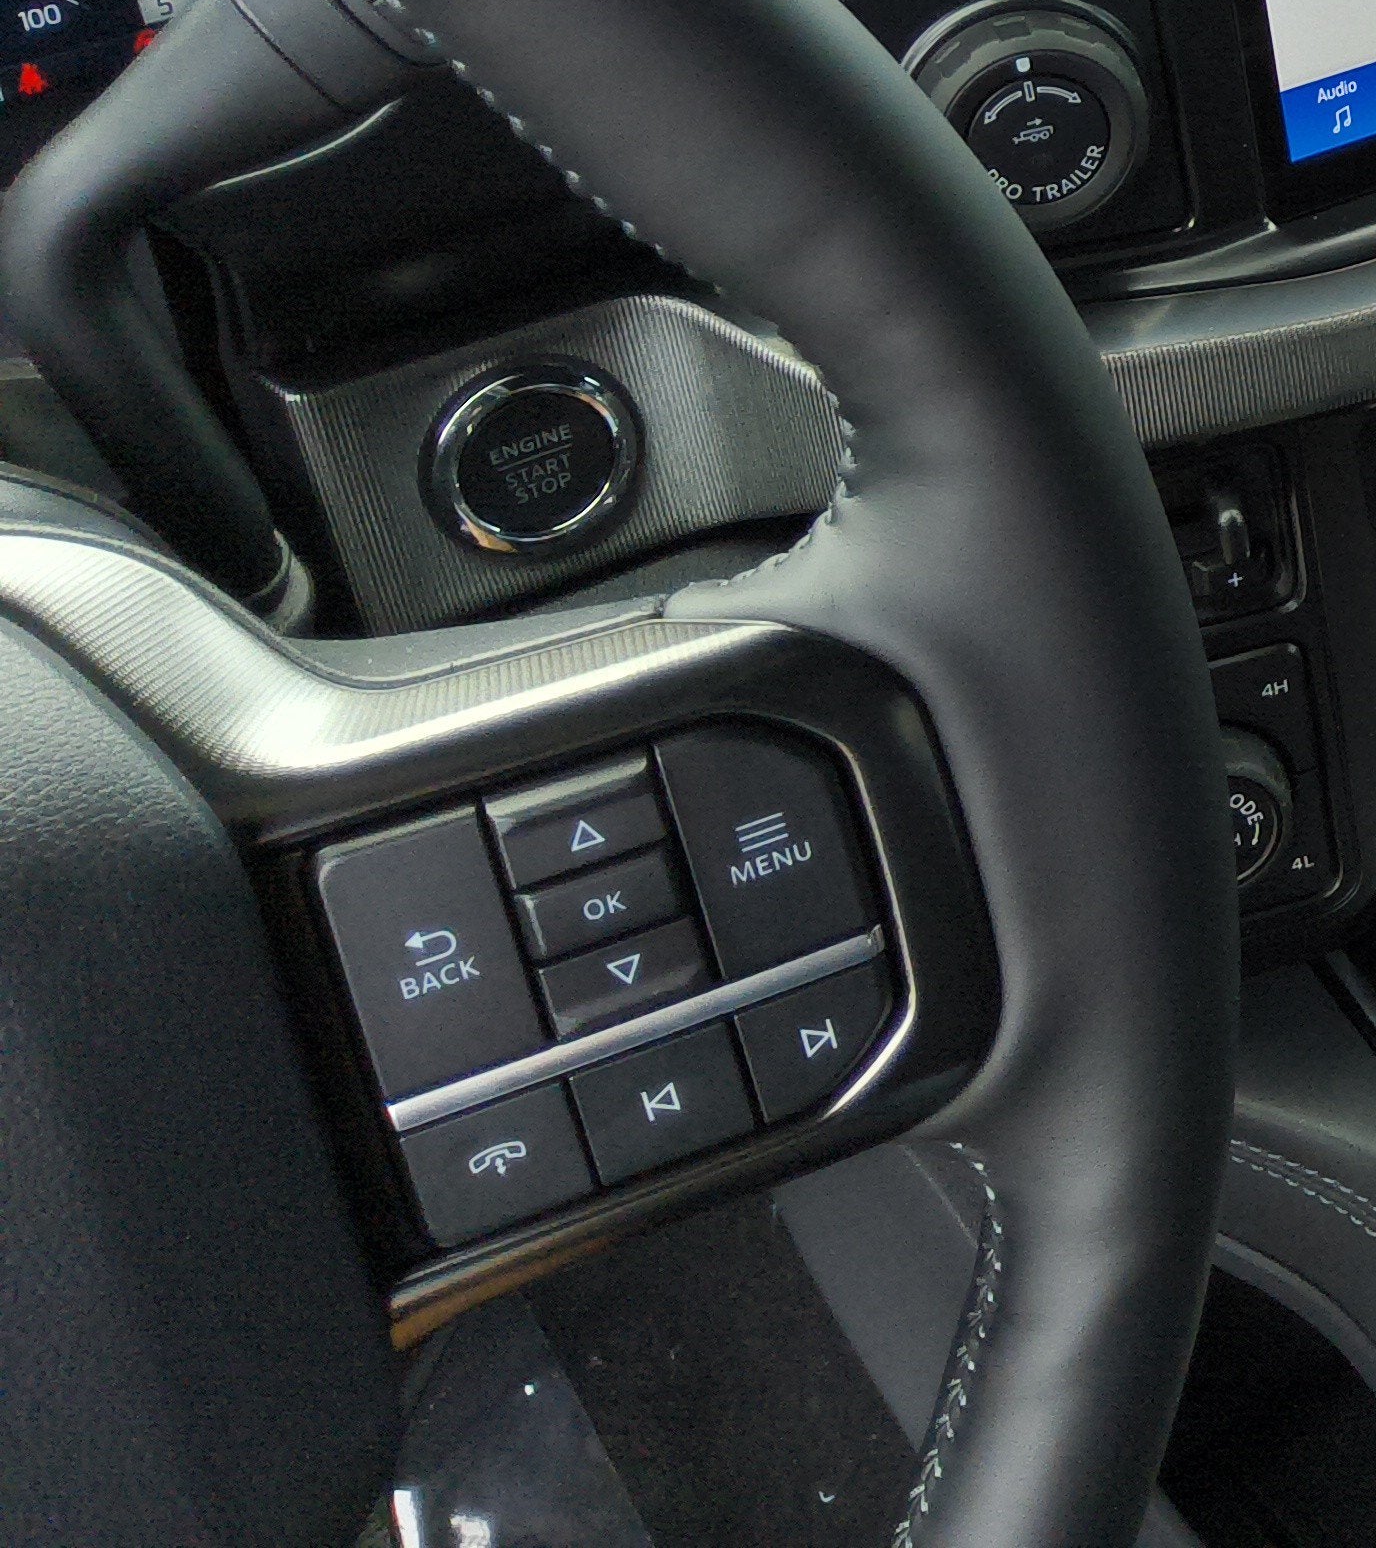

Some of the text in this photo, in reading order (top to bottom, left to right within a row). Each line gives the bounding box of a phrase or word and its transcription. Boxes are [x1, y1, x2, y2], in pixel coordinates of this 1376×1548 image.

[18, 3, 62, 32] 100
[1316, 77, 1357, 103] Audio
[1032, 145, 1105, 202] TRAILER
[489, 423, 573, 466] ENGINE
[505, 453, 571, 489] START
[515, 472, 572, 504] STOP
[1261, 678, 1289, 698] 4H
[1229, 793, 1264, 827] ODE
[729, 840, 813, 887] MENU
[1291, 855, 1315, 870] 4L
[583, 890, 627, 920] OK
[399, 955, 480, 1000] BACK
